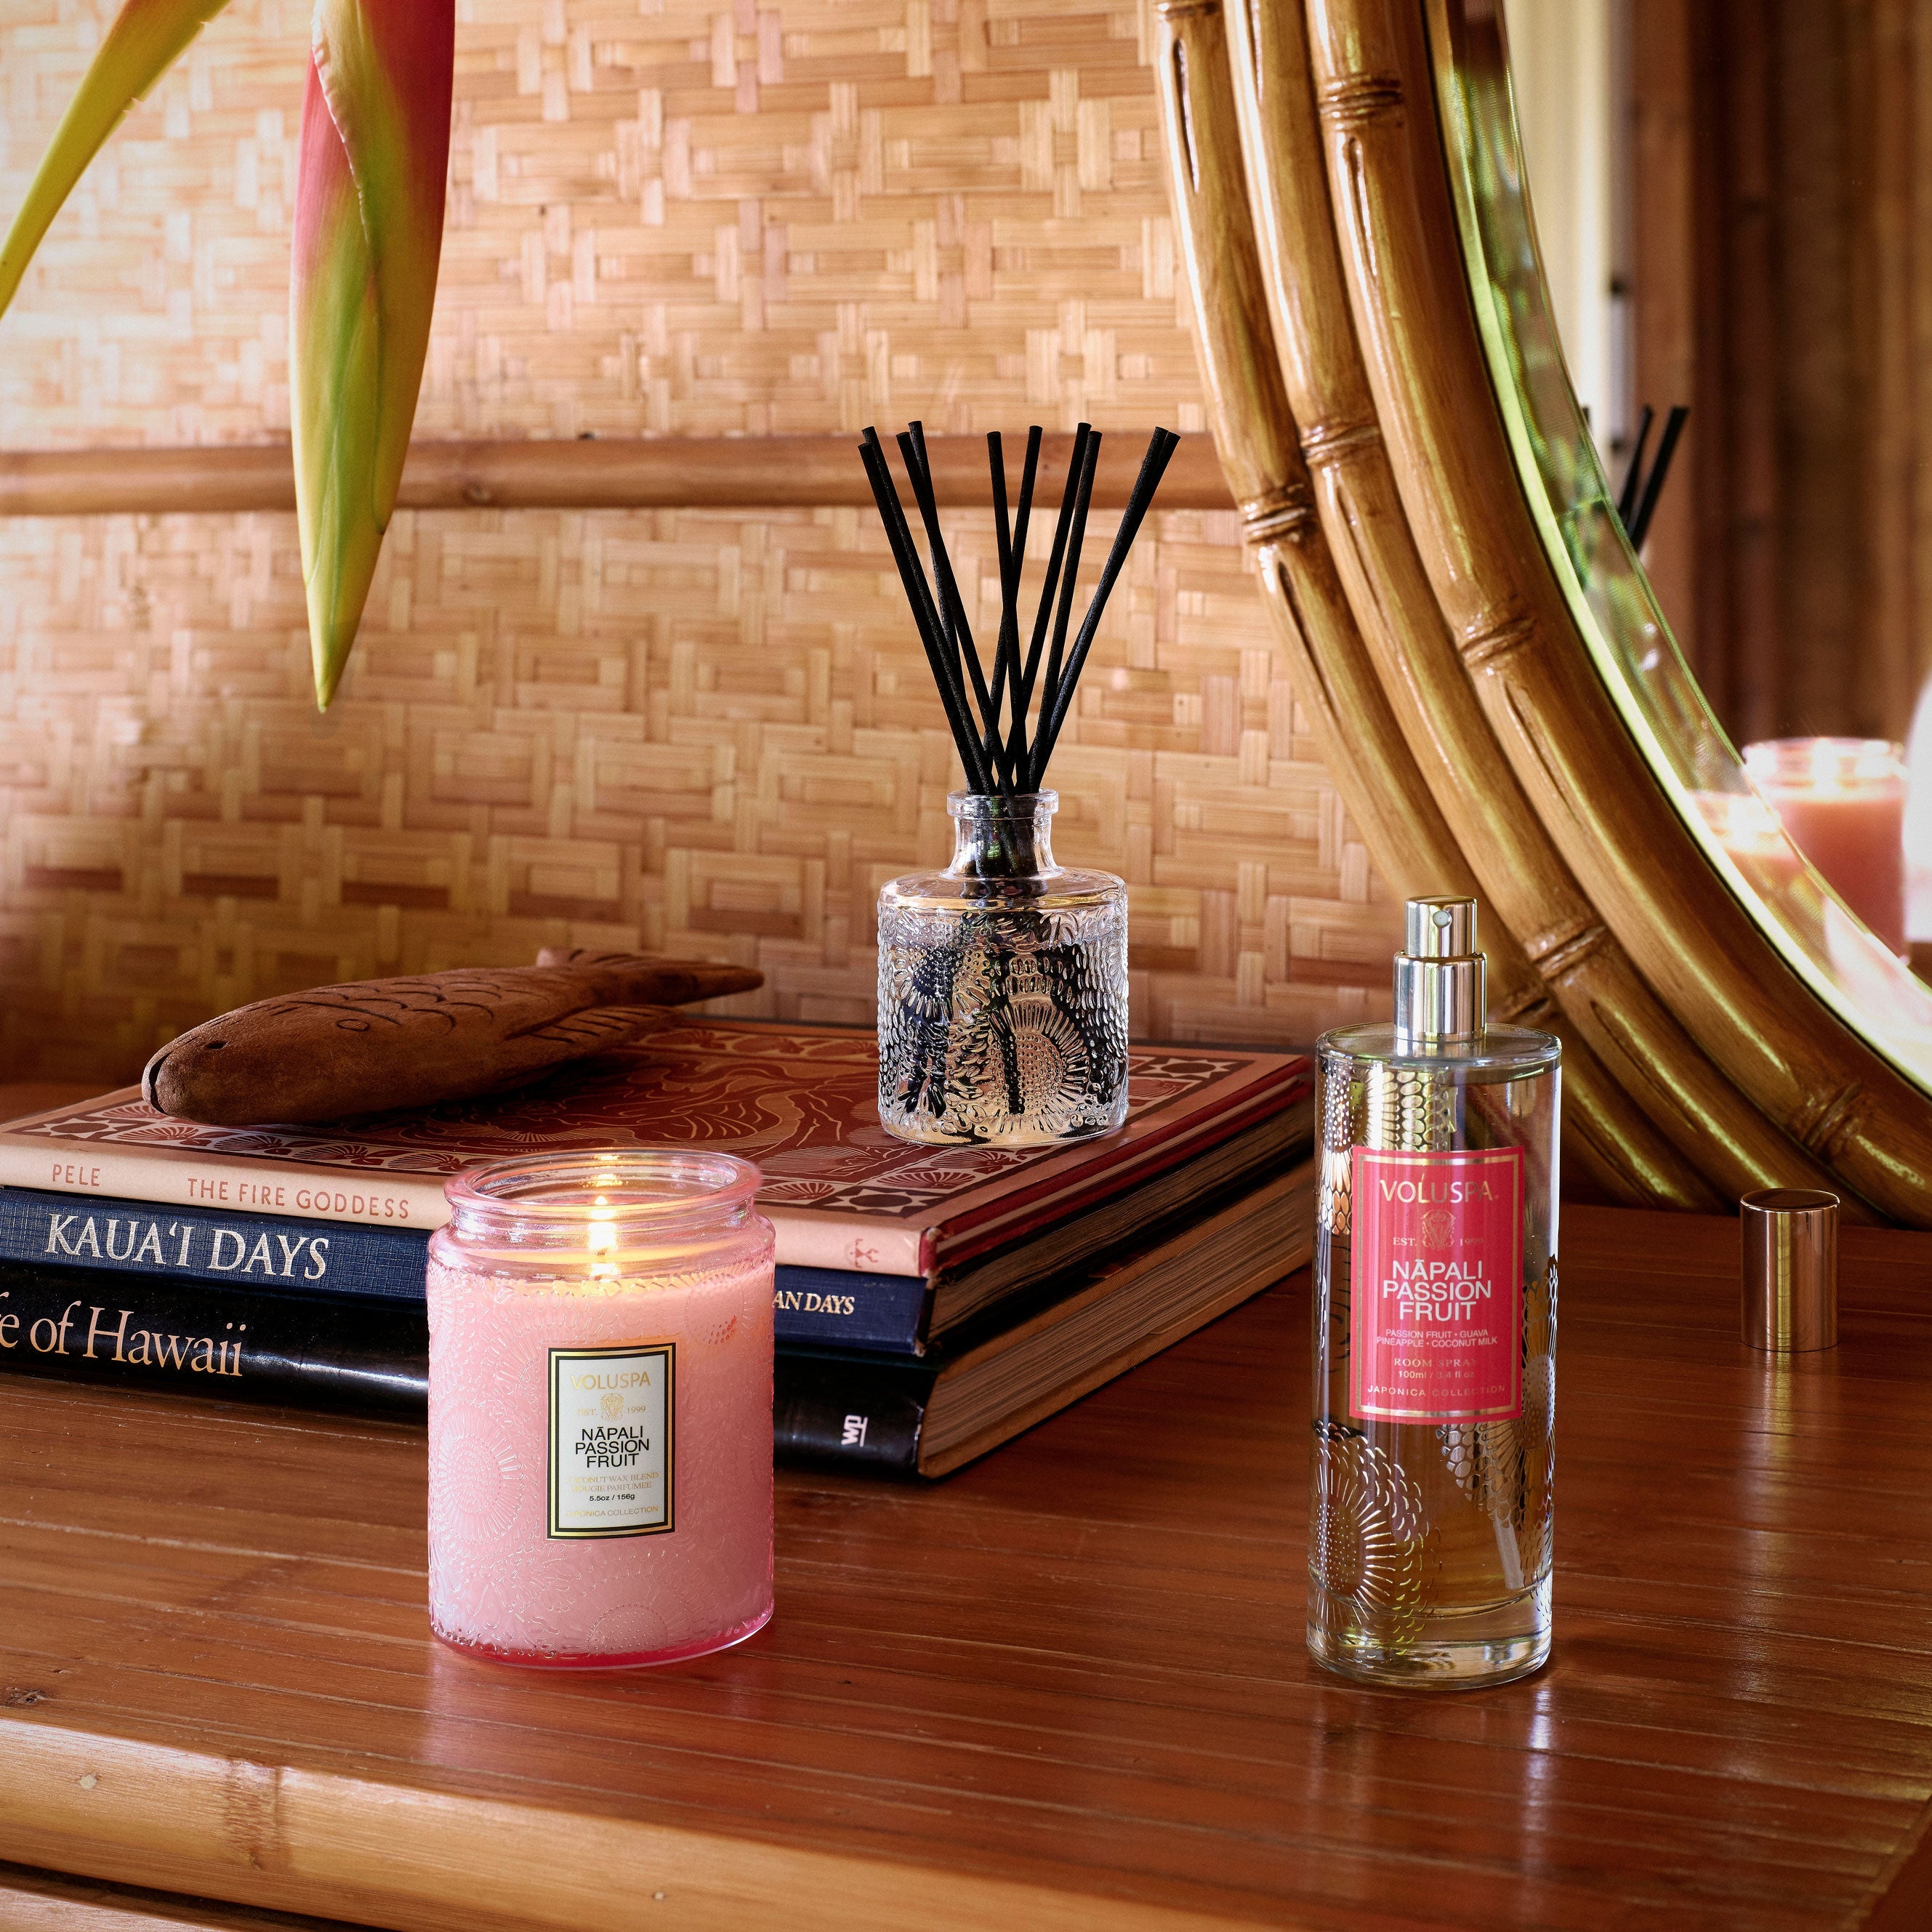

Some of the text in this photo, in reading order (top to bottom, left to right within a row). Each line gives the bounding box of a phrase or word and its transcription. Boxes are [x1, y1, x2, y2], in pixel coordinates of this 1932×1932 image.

[52, 1164, 409, 1219] PELE THE FIRE GODDESS
[1380, 1180, 1493, 1204] VOLUSPA
[1393, 1237, 1417, 1247] EST.
[208, 1229, 329, 1279] DAYS
[1392, 1259, 1482, 1280] NĀPALI
[1383, 1280, 1492, 1302] PASSION
[803, 1293, 856, 1316] DAYS
[1399, 1301, 1476, 1321] FRUIT
[30, 1300, 81, 1354] of
[83, 1307, 246, 1377] Hawaii
[1385, 1329, 1489, 1339] PASSION FRUIT GUAVA
[1376, 1336, 1497, 1348] PINEAPPLE COCONUT MILK
[1394, 1358, 1478, 1367] ROOM SPRAY
[571, 1372, 651, 1390] VOLUSPA
[1398, 1370, 1426, 1379] 100ml
[1368, 1385, 1505, 1397] JAPONICA COLLECTION
[578, 1408, 598, 1417] EST.
[581, 1425, 643, 1441] NĀPALI
[576, 1438, 650, 1455] PASSION
[587, 1453, 640, 1468] FRUIT
[630, 1472, 659, 1481] BLEND
[607, 1482, 652, 1492] PARFUMEE
[607, 1505, 659, 1516] COLLECTION
